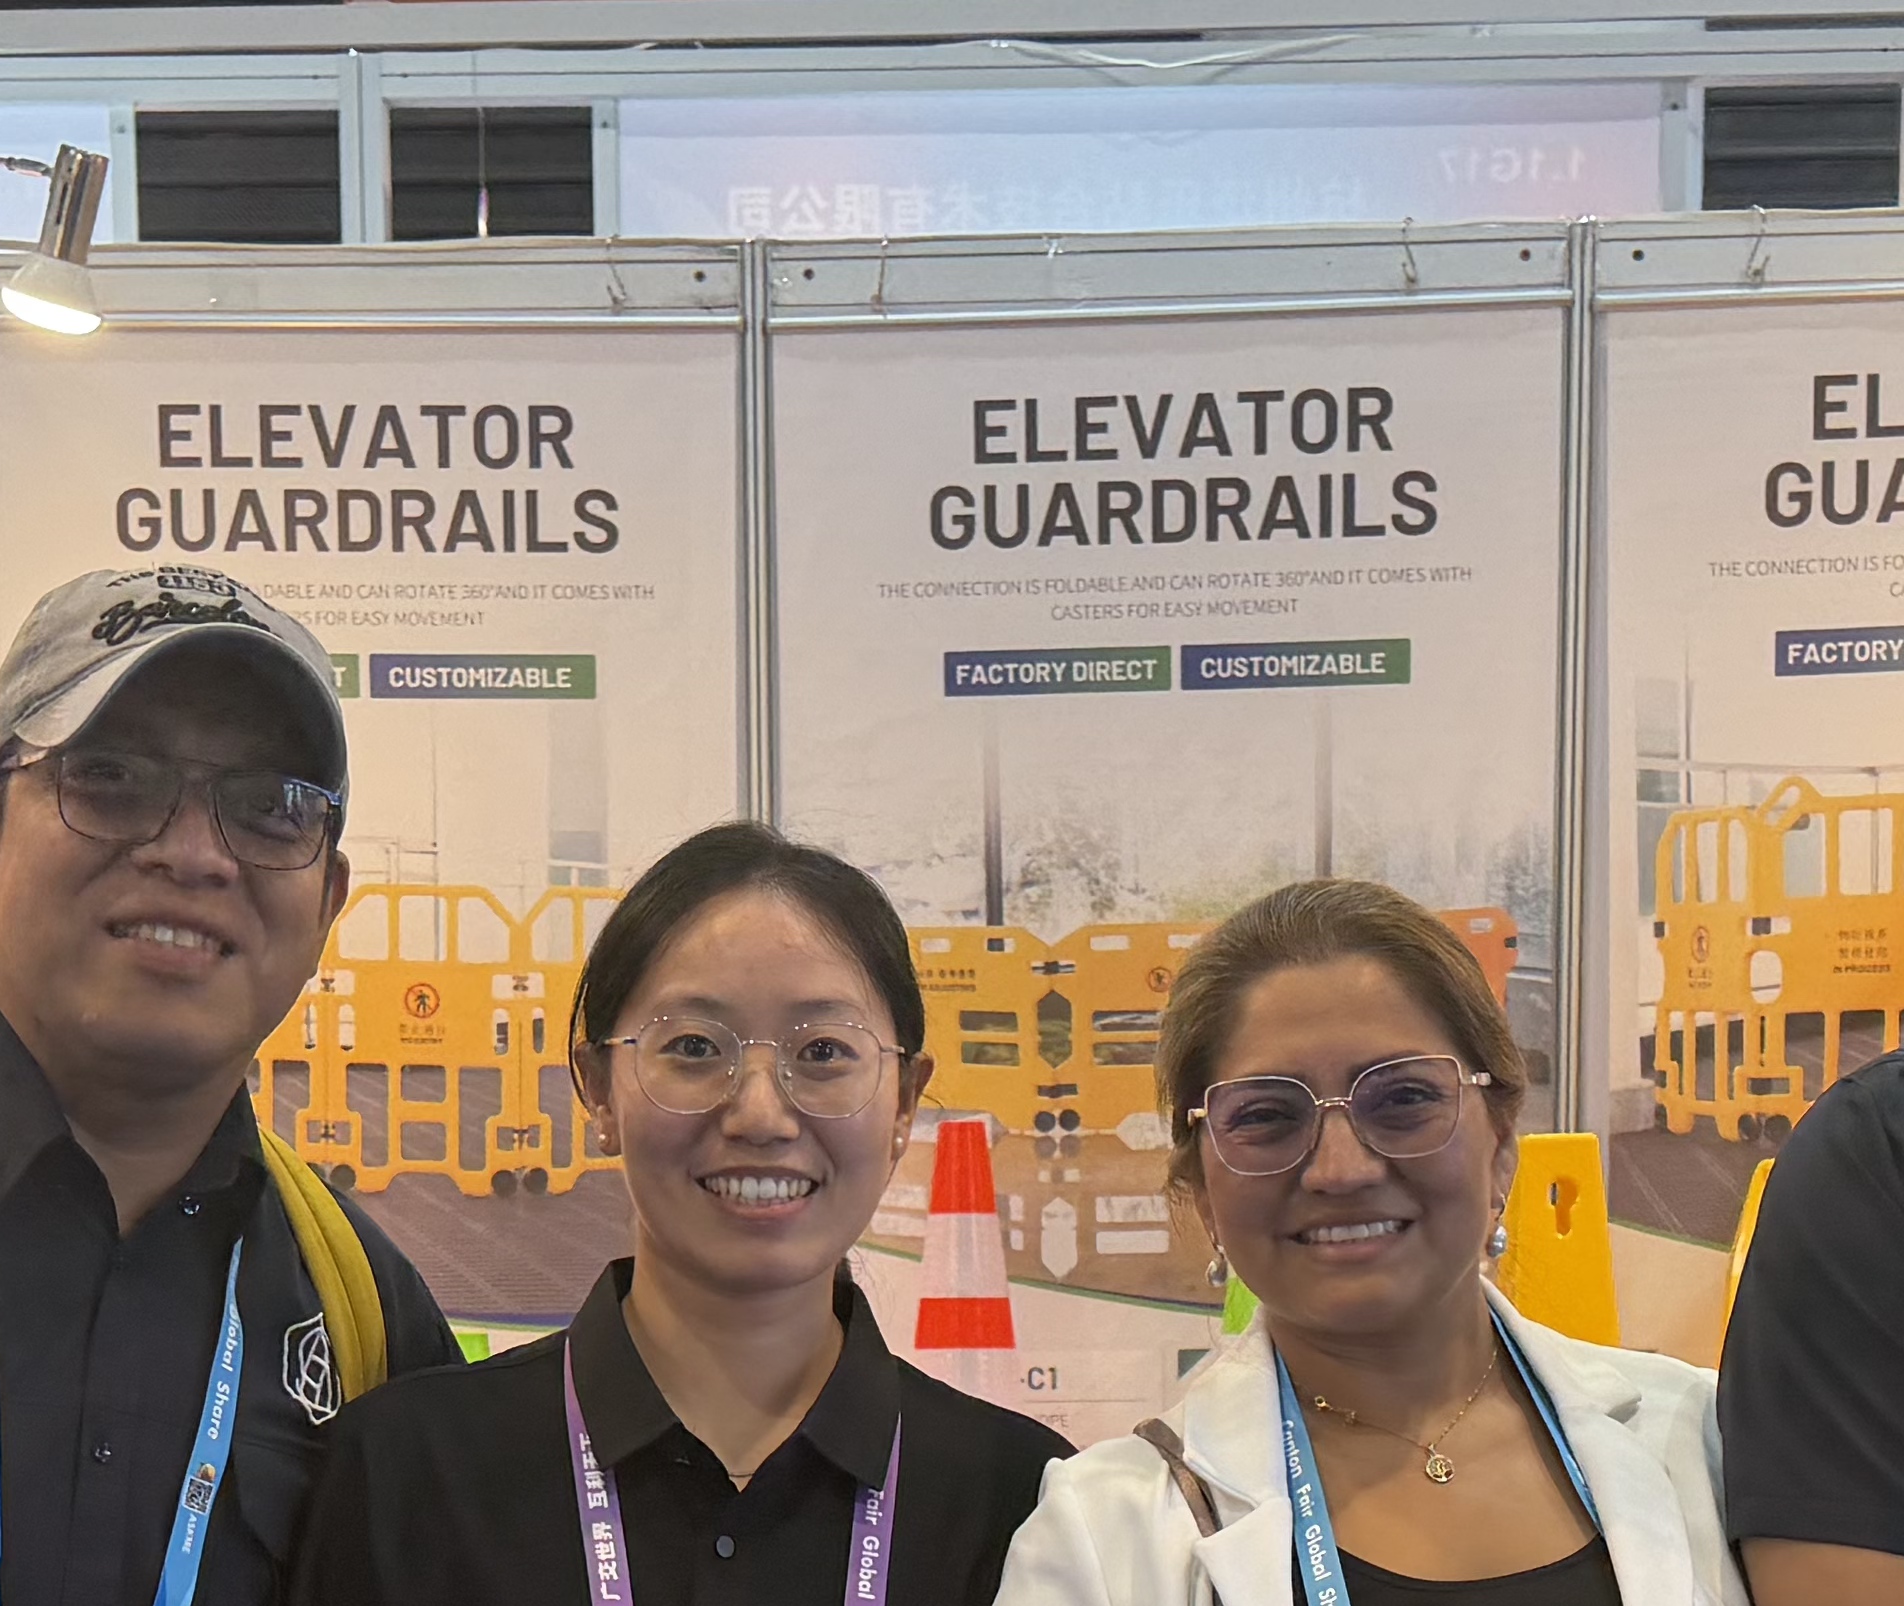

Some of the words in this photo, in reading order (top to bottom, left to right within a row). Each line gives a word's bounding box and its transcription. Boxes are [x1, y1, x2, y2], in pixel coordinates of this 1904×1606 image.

[157, 403, 574, 470] ELEVATOR
[973, 386, 1395, 464] ELEVATOR
[116, 488, 620, 554] GUARDRAILS
[929, 470, 1439, 550] GUARDRAILS
[879, 582, 910, 599] THE
[913, 580, 1022, 599] CONNECTION
[1025, 578, 1041, 595] IS
[1045, 575, 1127, 595] FOLDABLE
[1128, 574, 1166, 592] AND
[1169, 574, 1203, 591] CAN
[1207, 571, 1271, 590] ROTATE
[1348, 569, 1363, 586] IT
[1368, 567, 1427, 585] COMES
[1429, 565, 1473, 582] WITH
[1709, 561, 1743, 578] THE
[1746, 557, 1859, 576] CONNECTION
[1864, 555, 1879, 572] IS
[318, 584, 352, 600] AND
[356, 584, 391, 600] CAN
[395, 584, 456, 600] ROTATE
[533, 584, 545, 600] IT
[552, 583, 610, 600] COMES
[613, 583, 656, 600] WITH
[315, 610, 347, 627] FOR
[351, 610, 393, 627] EASY
[395, 610, 487, 627] MOVEMENT
[1050, 603, 1124, 622] CASTERS
[1127, 602, 1160, 620] FOR
[1164, 600, 1203, 618] EASY
[1207, 598, 1299, 618] MOVEMENT
[1200, 652, 1386, 679] CUSTOMIZABLE
[1787, 639, 1904, 665] FACTORY
[388, 666, 573, 689] CUSTOMIZABLE
[955, 661, 1067, 686] FACTORY
[1072, 659, 1158, 683] DIRECT
[206, 1380, 231, 1440] Share
[864, 1487, 884, 1526] Fair
[1296, 1484, 1314, 1518] Fair
[592, 1521, 621, 1602] 广交世界
[857, 1535, 881, 1600] Global
[1304, 1524, 1332, 1582] Global
